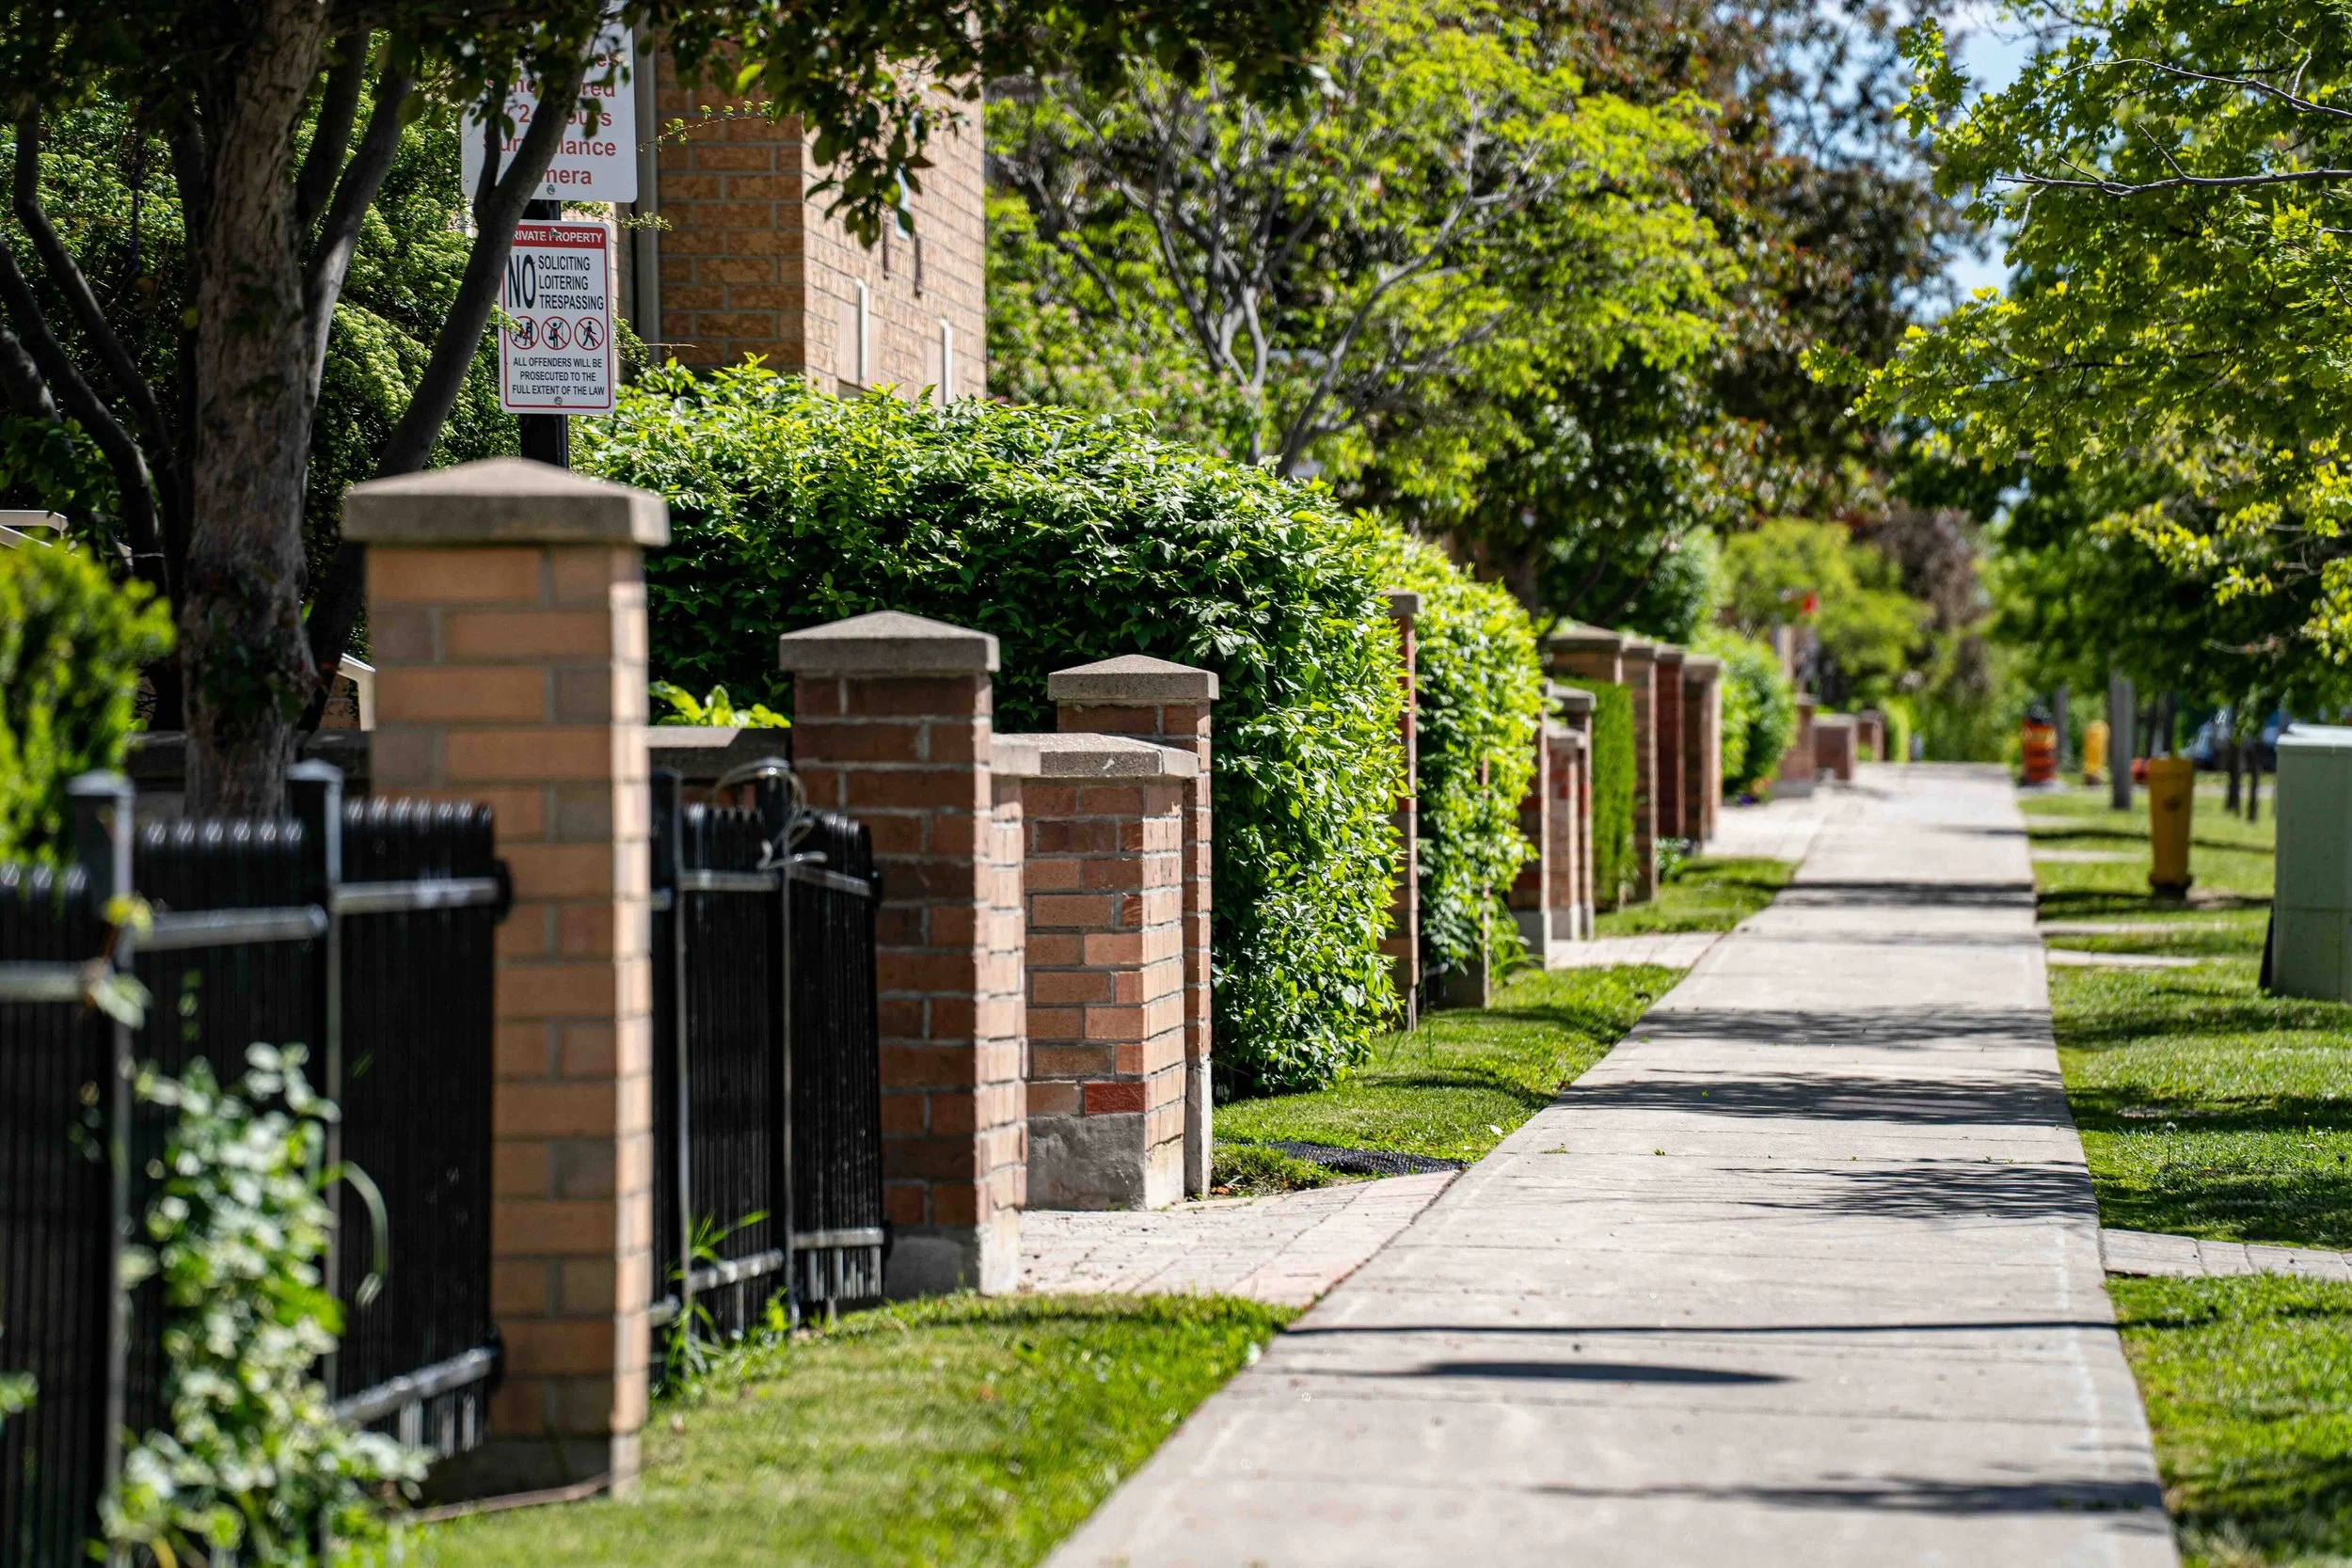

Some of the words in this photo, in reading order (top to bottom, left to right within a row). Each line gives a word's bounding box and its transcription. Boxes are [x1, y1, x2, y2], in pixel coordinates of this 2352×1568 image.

[514, 230, 547, 241] RIVATE
[538, 255, 591, 271] SOLICITING
[508, 254, 536, 309] NO
[539, 275, 589, 291] LOITERING
[539, 294, 604, 310] TRESPASSING
[513, 356, 527, 367] ALL
[529, 357, 572, 368] OFFENDERS
[573, 358, 591, 368] WILL
[593, 358, 602, 368] BE
[520, 371, 569, 381] PROSECUTED
[571, 372, 580, 381] TO
[581, 372, 596, 382] THE
[513, 384, 531, 394] FULL
[532, 385, 560, 395] EXTENT
[562, 385, 571, 395] OF
[573, 386, 587, 395] THE
[589, 386, 605, 396] LAW
